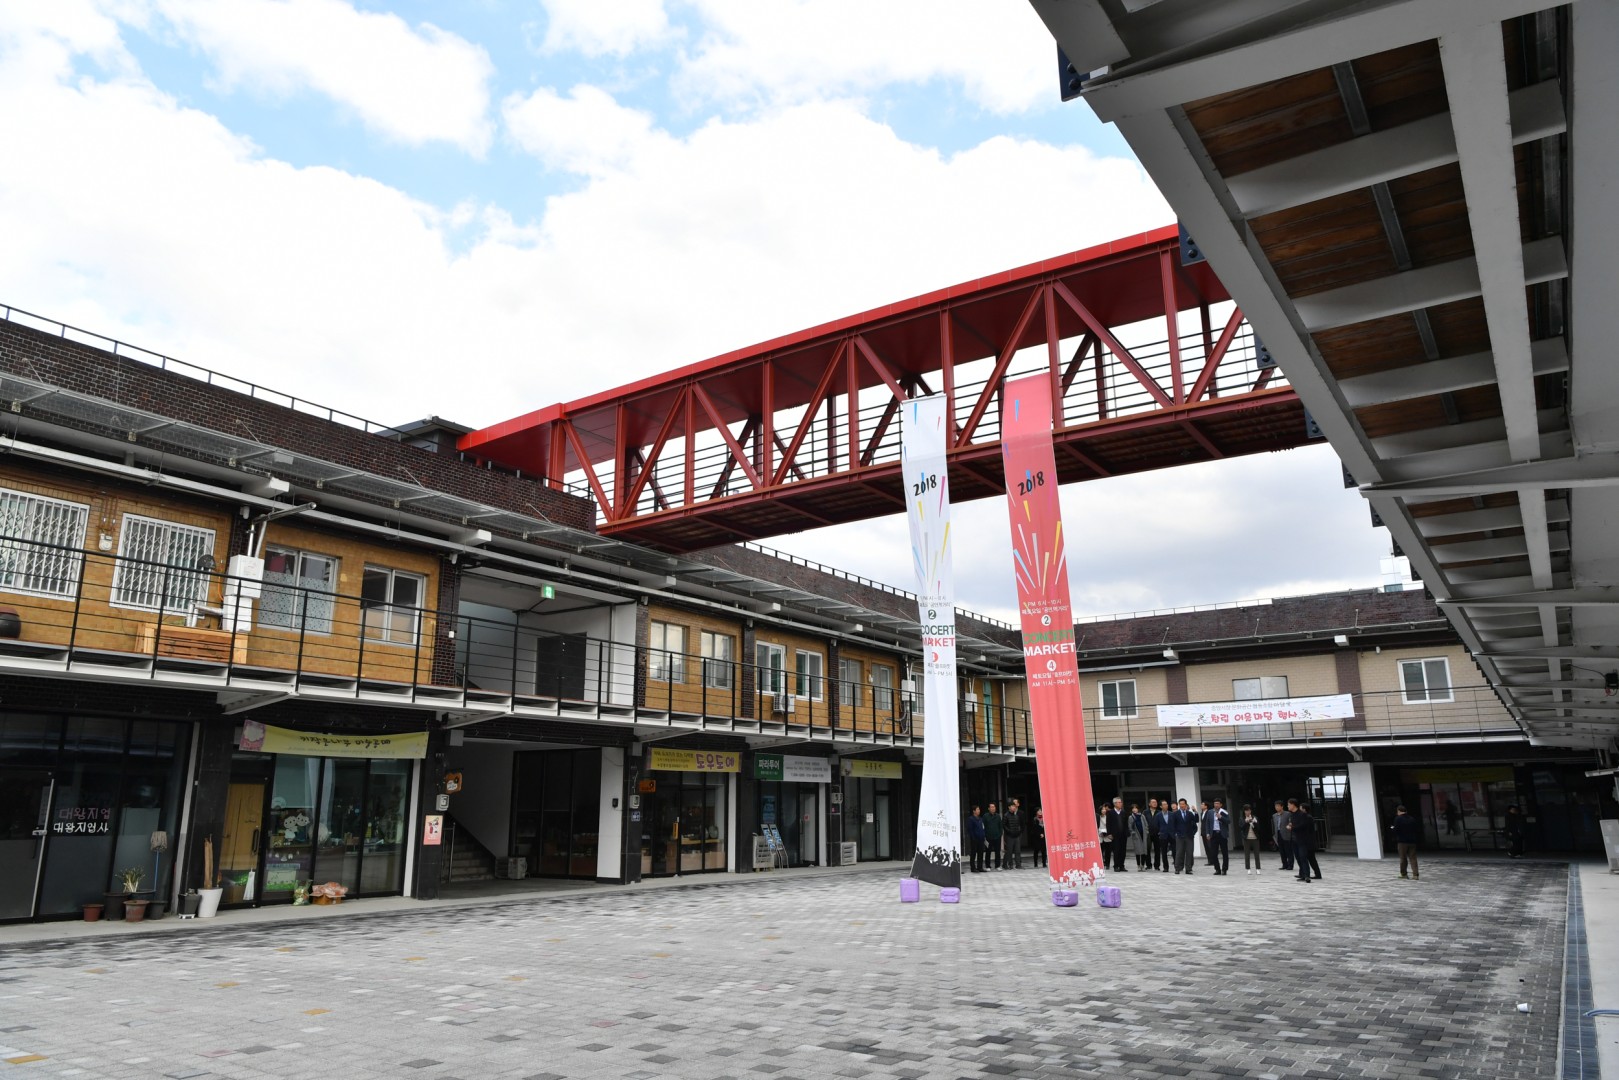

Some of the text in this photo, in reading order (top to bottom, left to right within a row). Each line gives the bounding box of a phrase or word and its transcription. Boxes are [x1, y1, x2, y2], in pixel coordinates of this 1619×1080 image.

[913, 474, 937, 496] 2018
[1017, 471, 1045, 496] 2018
[1023, 629, 1074, 645] CONCERT
[1023, 642, 1076, 657] MARKET
[695, 753, 735, 770] 도우도예
[53, 821, 109, 834] 대왕지업사
